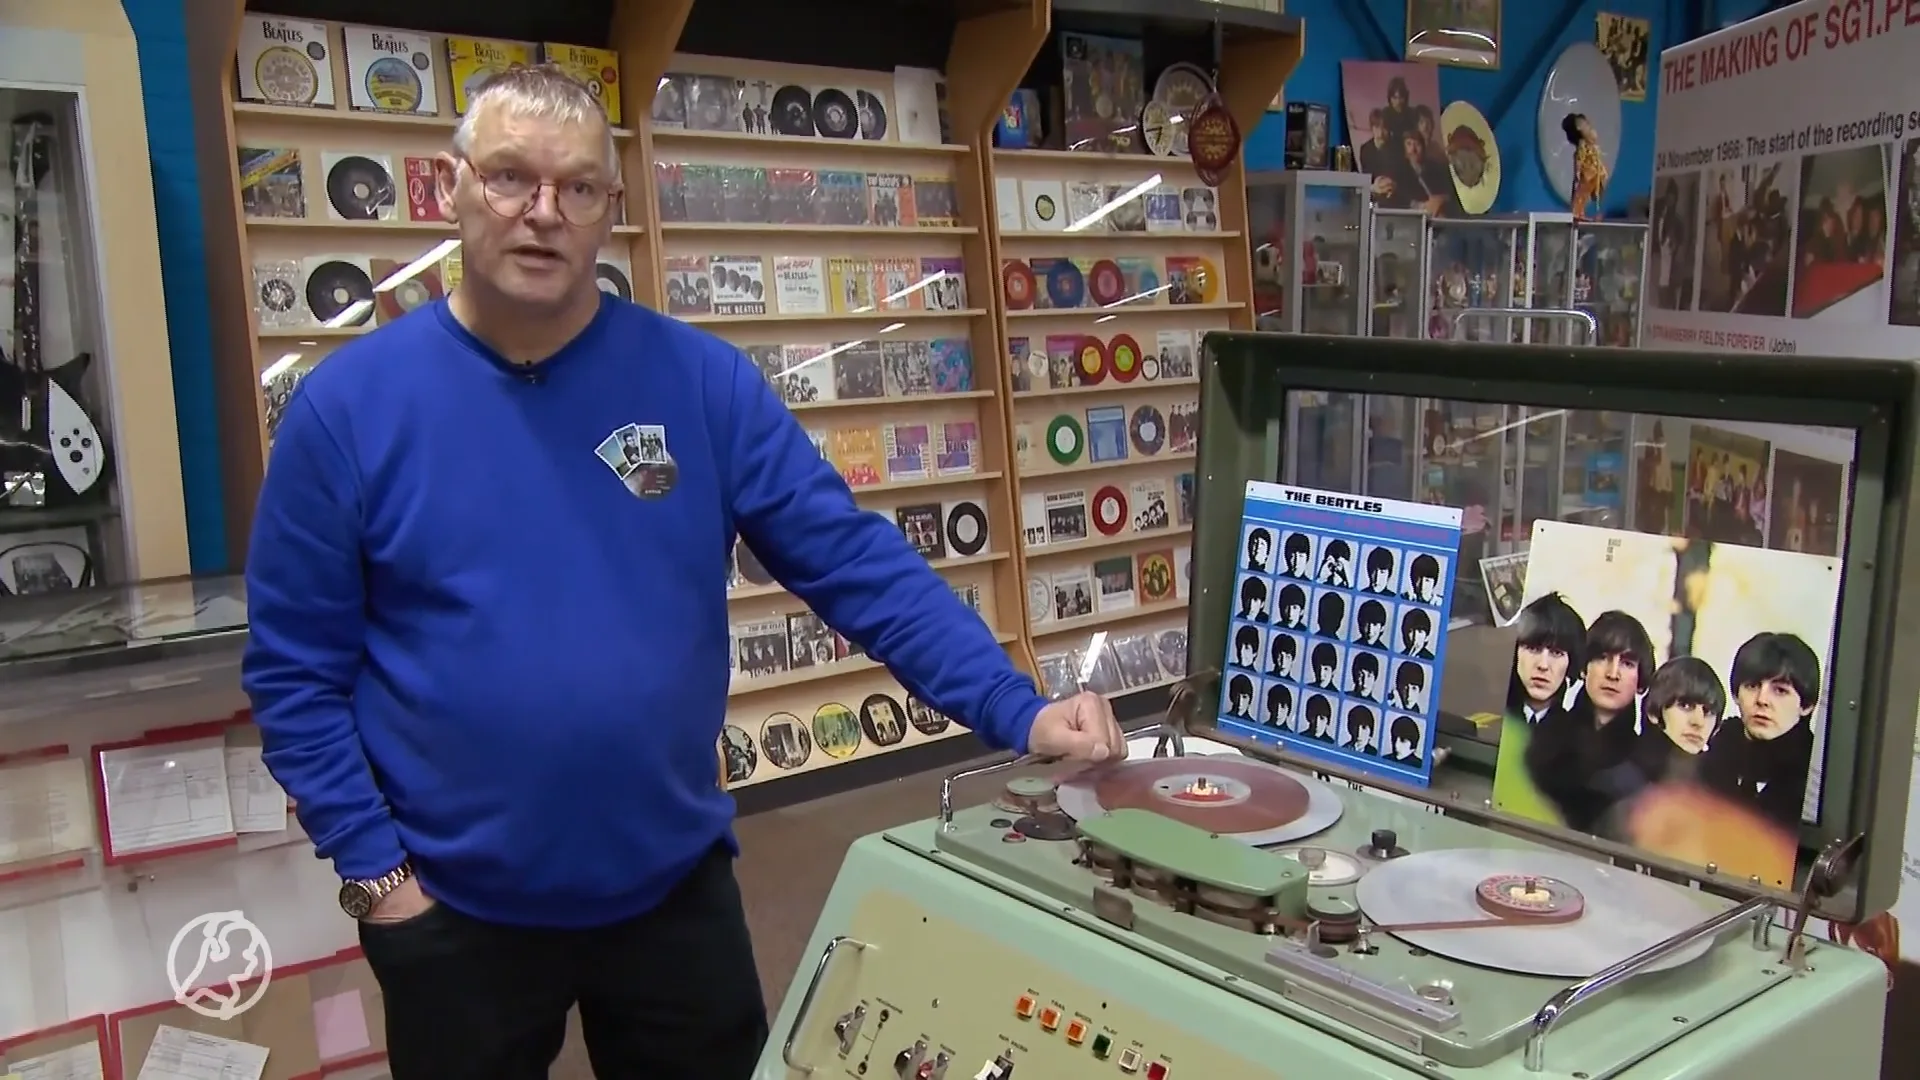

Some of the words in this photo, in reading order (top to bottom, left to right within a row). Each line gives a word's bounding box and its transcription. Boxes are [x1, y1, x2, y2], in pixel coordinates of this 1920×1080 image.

[263, 21, 304, 43] BEATLES
[371, 33, 409, 54] BEATLES
[1664, 56, 1696, 94] THE
[1700, 26, 1778, 86] MAKING
[1785, 12, 1819, 62] OF
[1668, 147, 1714, 169] November
[1747, 136, 1766, 157] The
[1769, 131, 1796, 154] start
[1798, 129, 1811, 149] of
[1813, 124, 1834, 146] the
[1836, 111, 1904, 143] recording
[1699, 330, 1725, 346] FIELDS
[1726, 332, 1765, 350] FOREVER
[1769, 338, 1797, 353] (John)
[1284, 490, 1312, 503] THE
[1315, 494, 1382, 513] BEATLES
